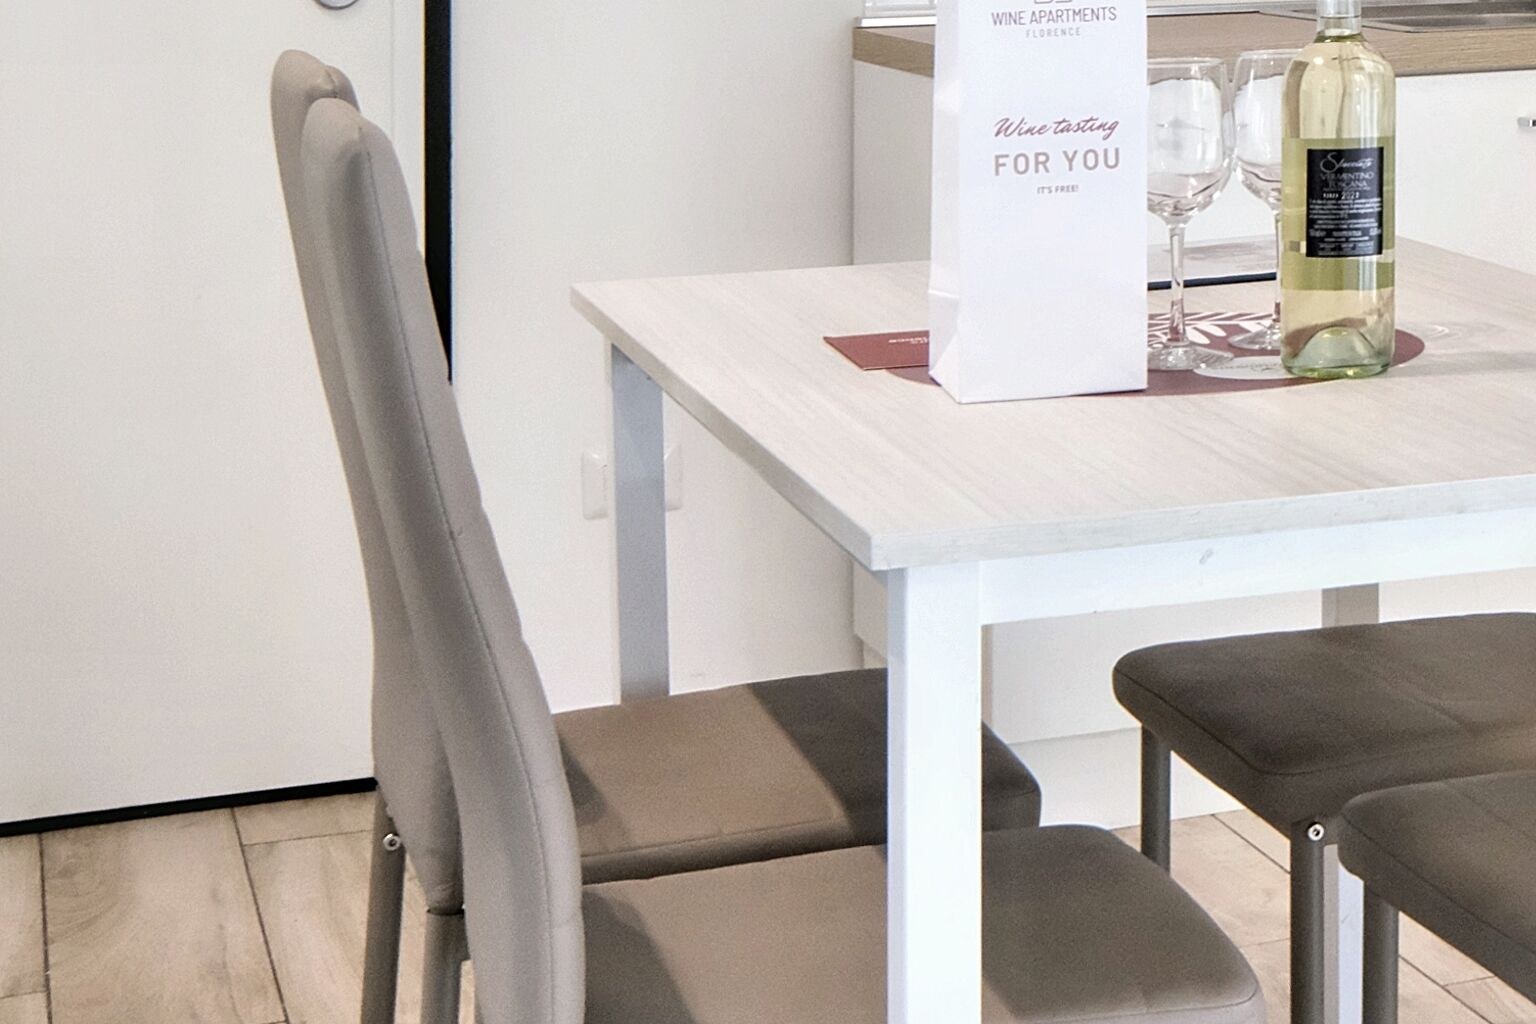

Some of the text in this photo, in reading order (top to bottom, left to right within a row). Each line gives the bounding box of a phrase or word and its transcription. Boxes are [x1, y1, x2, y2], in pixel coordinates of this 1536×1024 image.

[991, 6, 1118, 26] WINE APARTMENTS
[1025, 27, 1081, 39] FLORENCE
[993, 115, 1120, 141] Wine tasting
[993, 147, 1120, 177] FOR YOU
